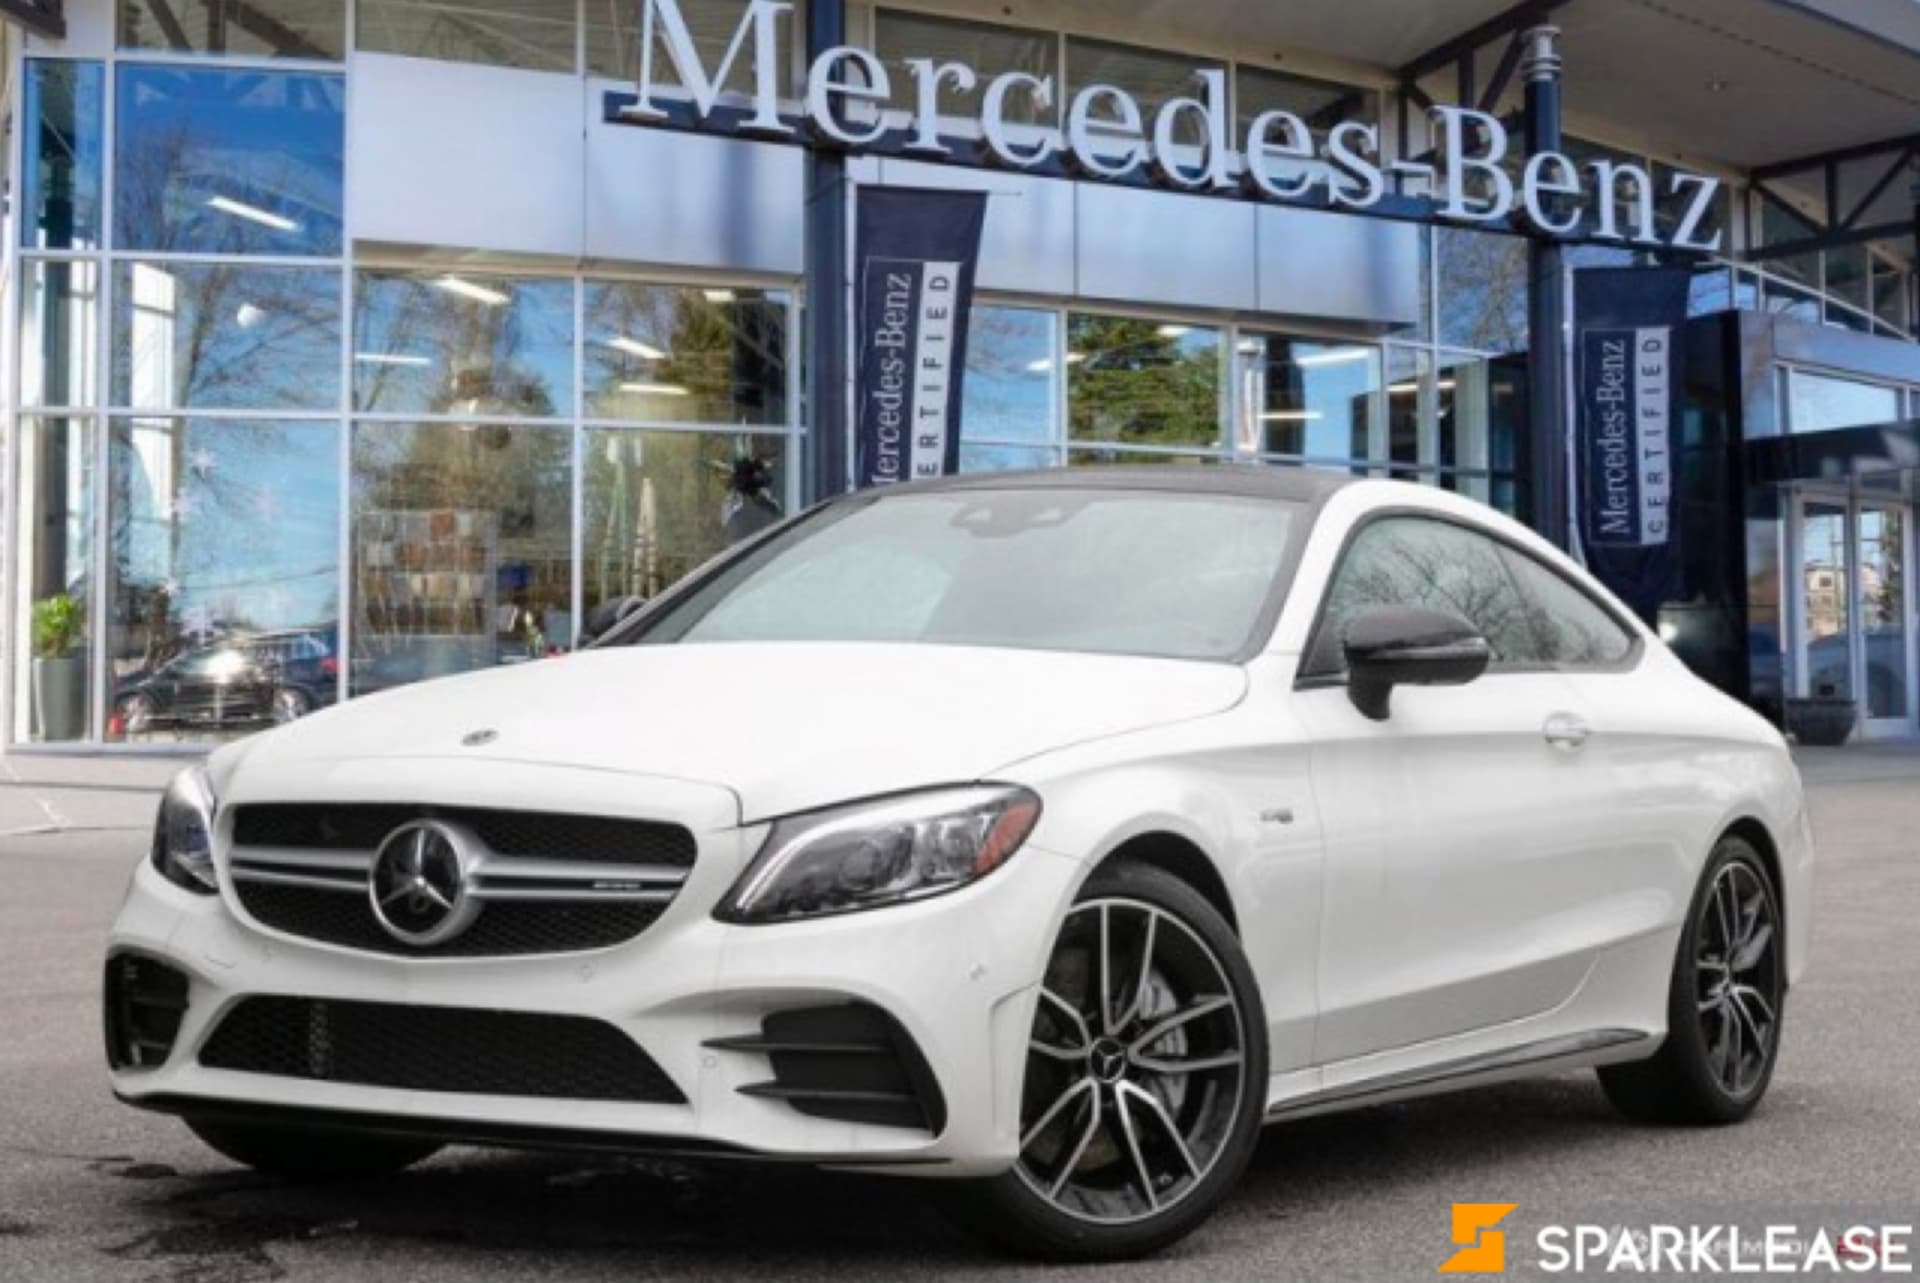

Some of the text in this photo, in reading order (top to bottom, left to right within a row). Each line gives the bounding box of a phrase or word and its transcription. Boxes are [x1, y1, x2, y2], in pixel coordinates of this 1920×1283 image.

[621, 0, 1721, 252] Mercedes-Benz
[917, 275, 949, 475] ERTIFIED
[1596, 339, 1630, 534] Mercedes-Benz
[1641, 339, 1665, 533] CERTIFIED
